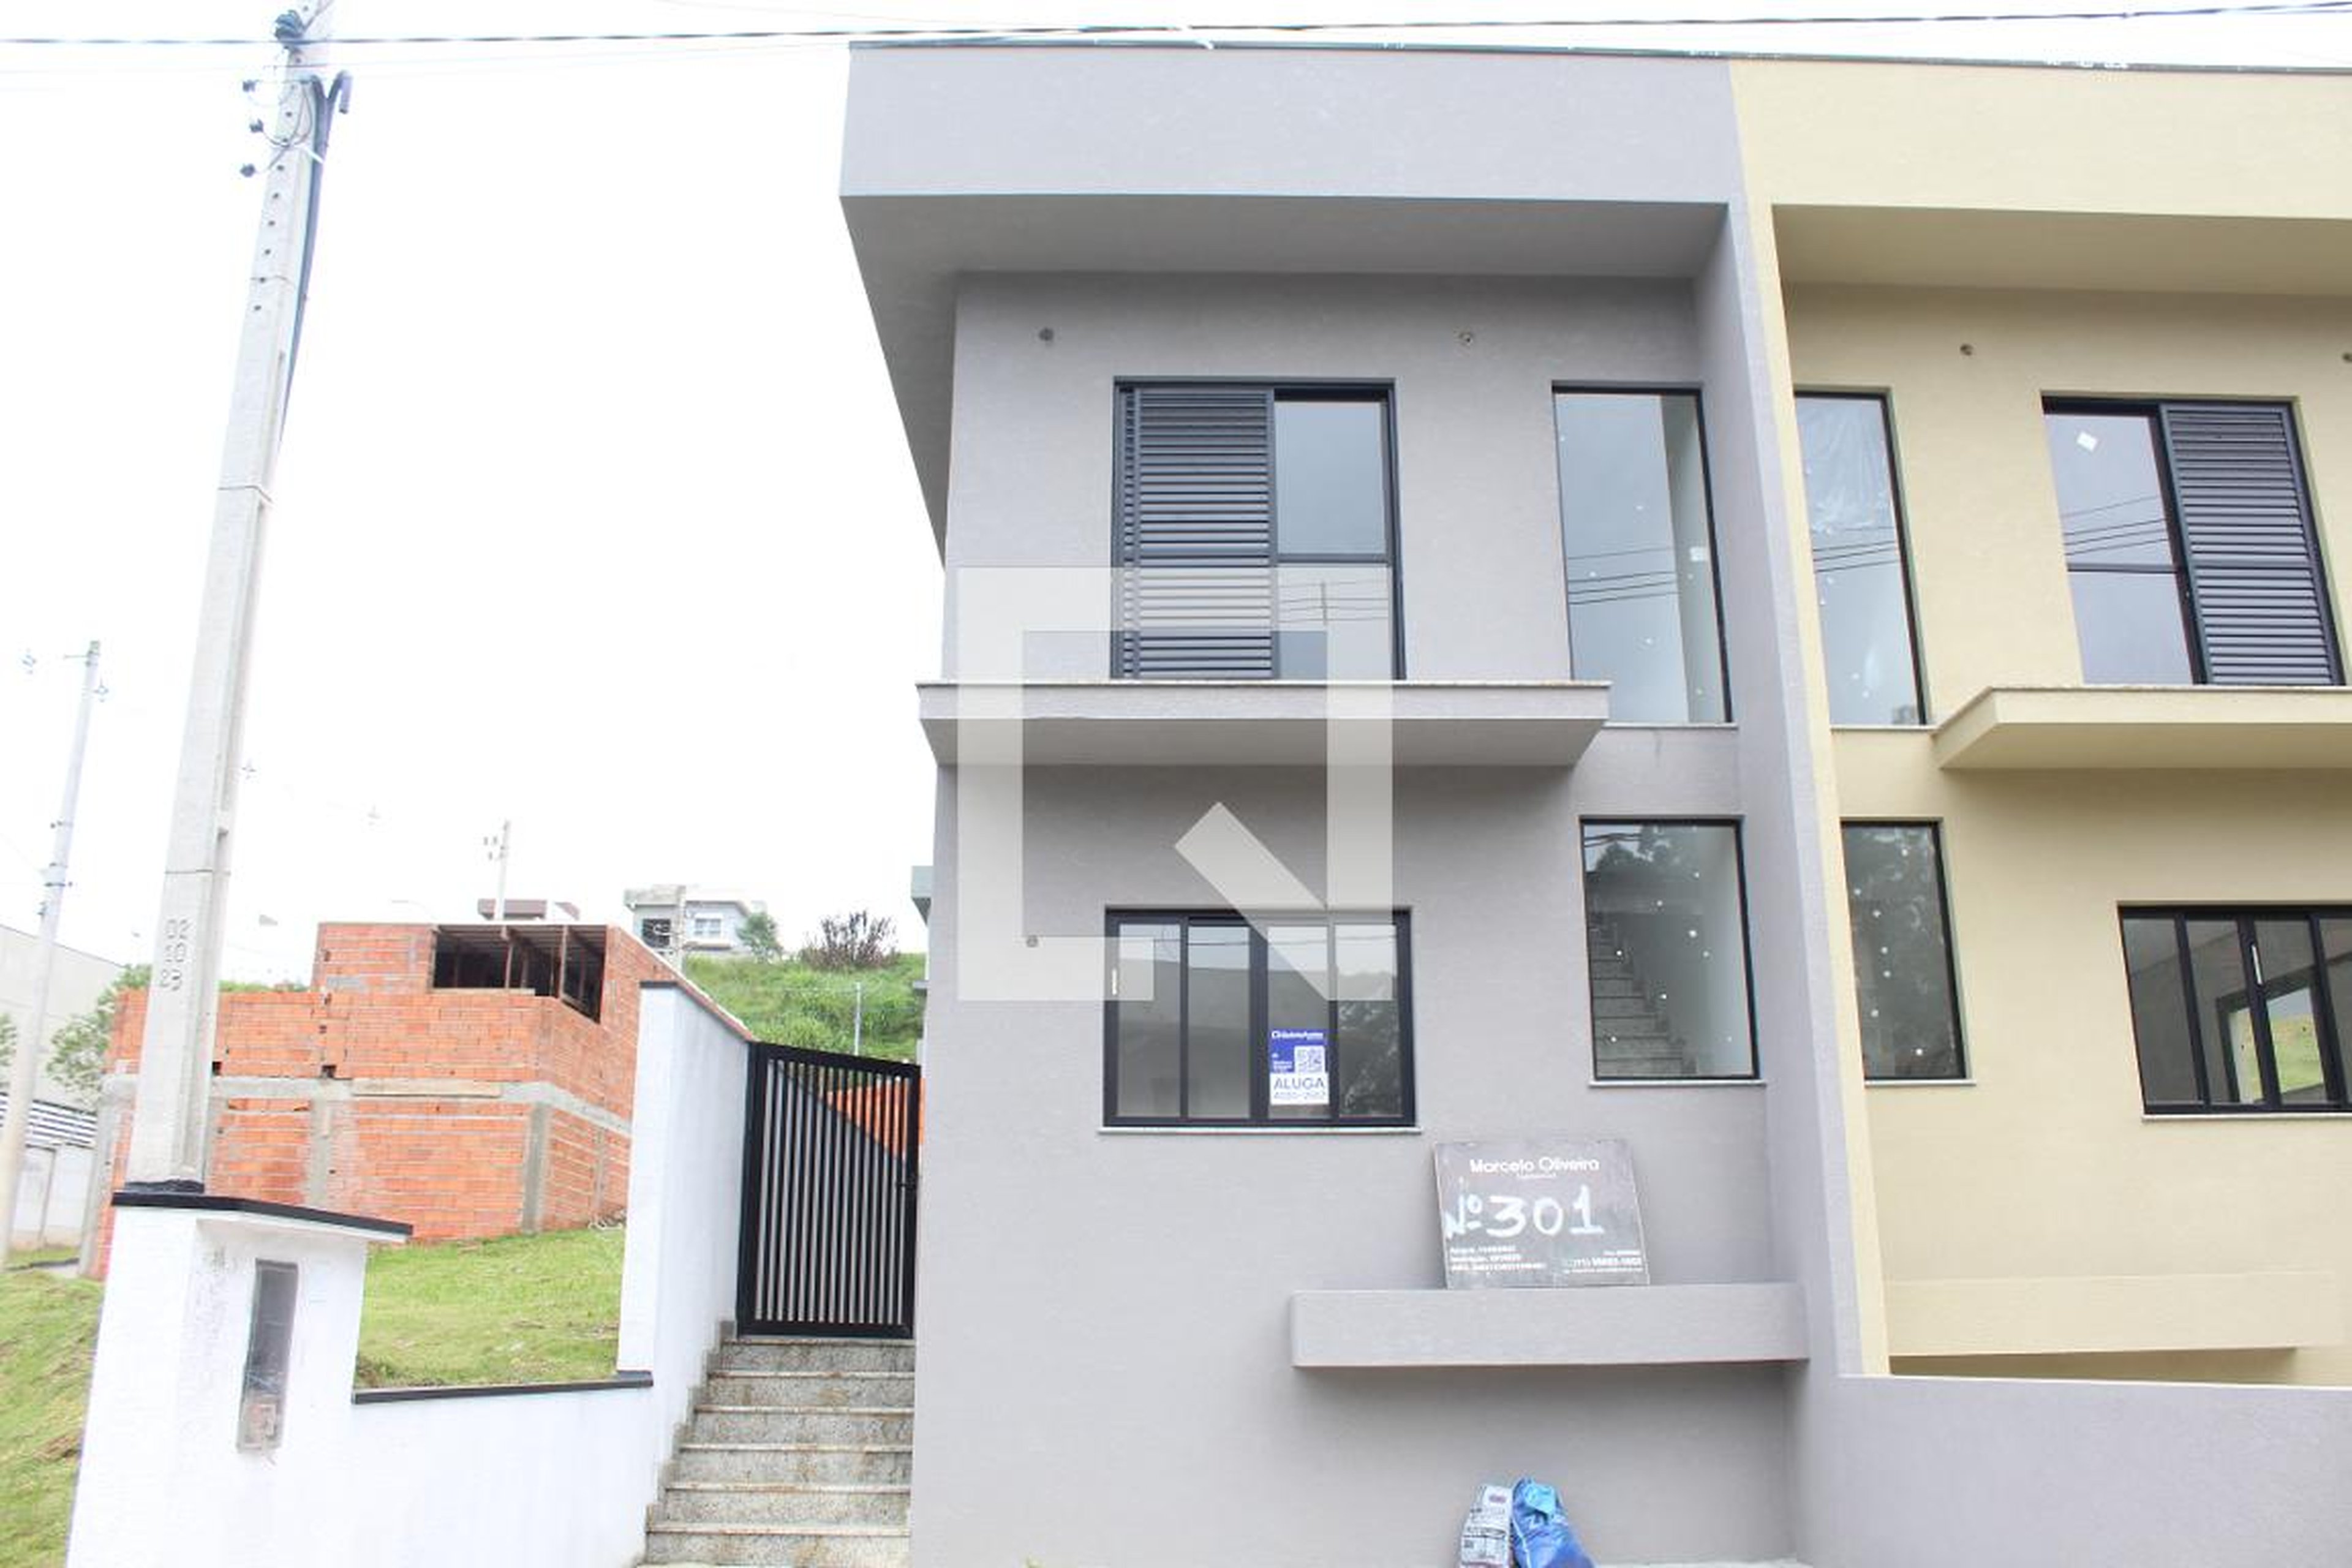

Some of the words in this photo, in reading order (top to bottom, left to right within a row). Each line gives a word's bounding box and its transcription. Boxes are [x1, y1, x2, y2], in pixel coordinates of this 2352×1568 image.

[1273, 1077, 1325, 1090] ALUGA
[1469, 1159, 1534, 1174] Marcelo
[1539, 1156, 1600, 1172] Oliveira
